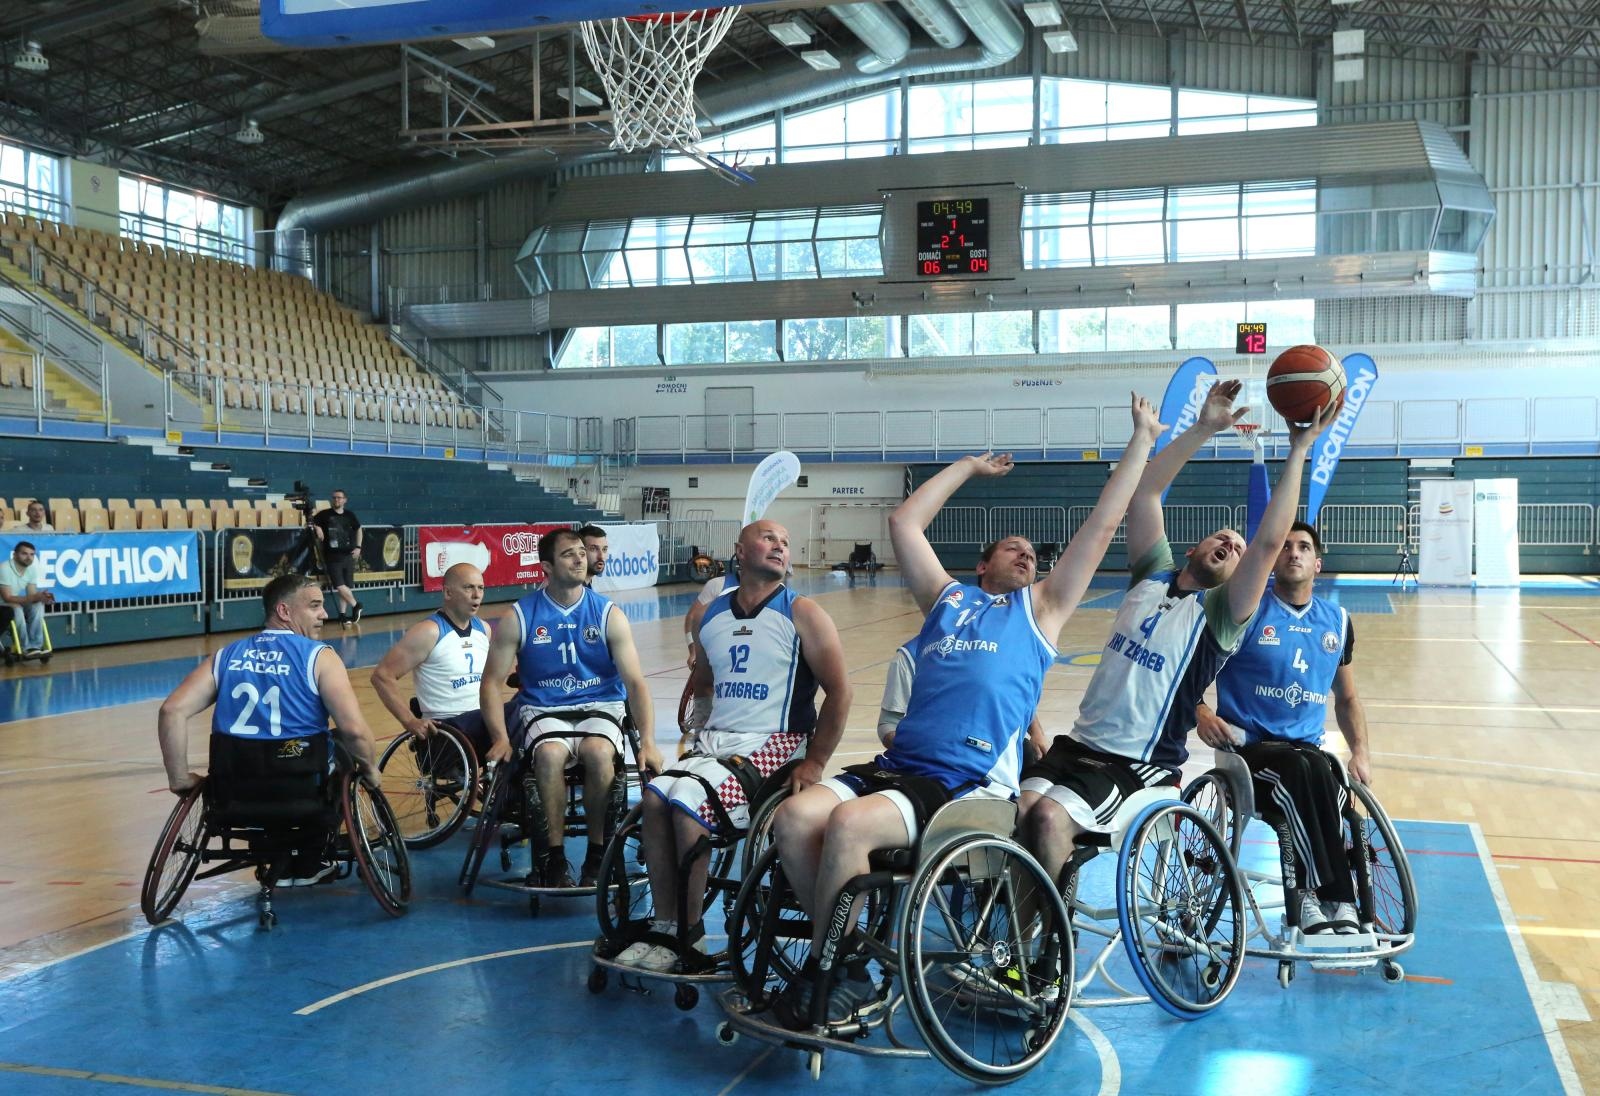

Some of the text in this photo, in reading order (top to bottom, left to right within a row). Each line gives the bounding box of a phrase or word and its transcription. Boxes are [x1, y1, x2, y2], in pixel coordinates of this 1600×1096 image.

[933, 201, 972, 215] 04:49
[951, 219, 957, 230] 1
[940, 234, 965, 248] 2 1
[969, 250, 987, 258] GOSTI
[924, 261, 941, 274] 06
[970, 258, 988, 272] 04
[1239, 324, 1264, 333] 04:49
[1245, 334, 1265, 353] 12
[1311, 367, 1377, 486] DECATHLON
[832, 487, 858, 495] PARTER
[503, 532, 544, 555] COSTE
[11, 545, 188, 588] ECATHLON
[1140, 611, 1162, 639] 4
[464, 652, 474, 674] 7
[557, 642, 577, 665] 11
[728, 644, 750, 673] 12
[1292, 647, 1309, 674] 4
[538, 678, 561, 688] INKO
[724, 681, 769, 700] ZAGREB
[1255, 684, 1284, 699] INKO
[229, 682, 282, 737] 21
